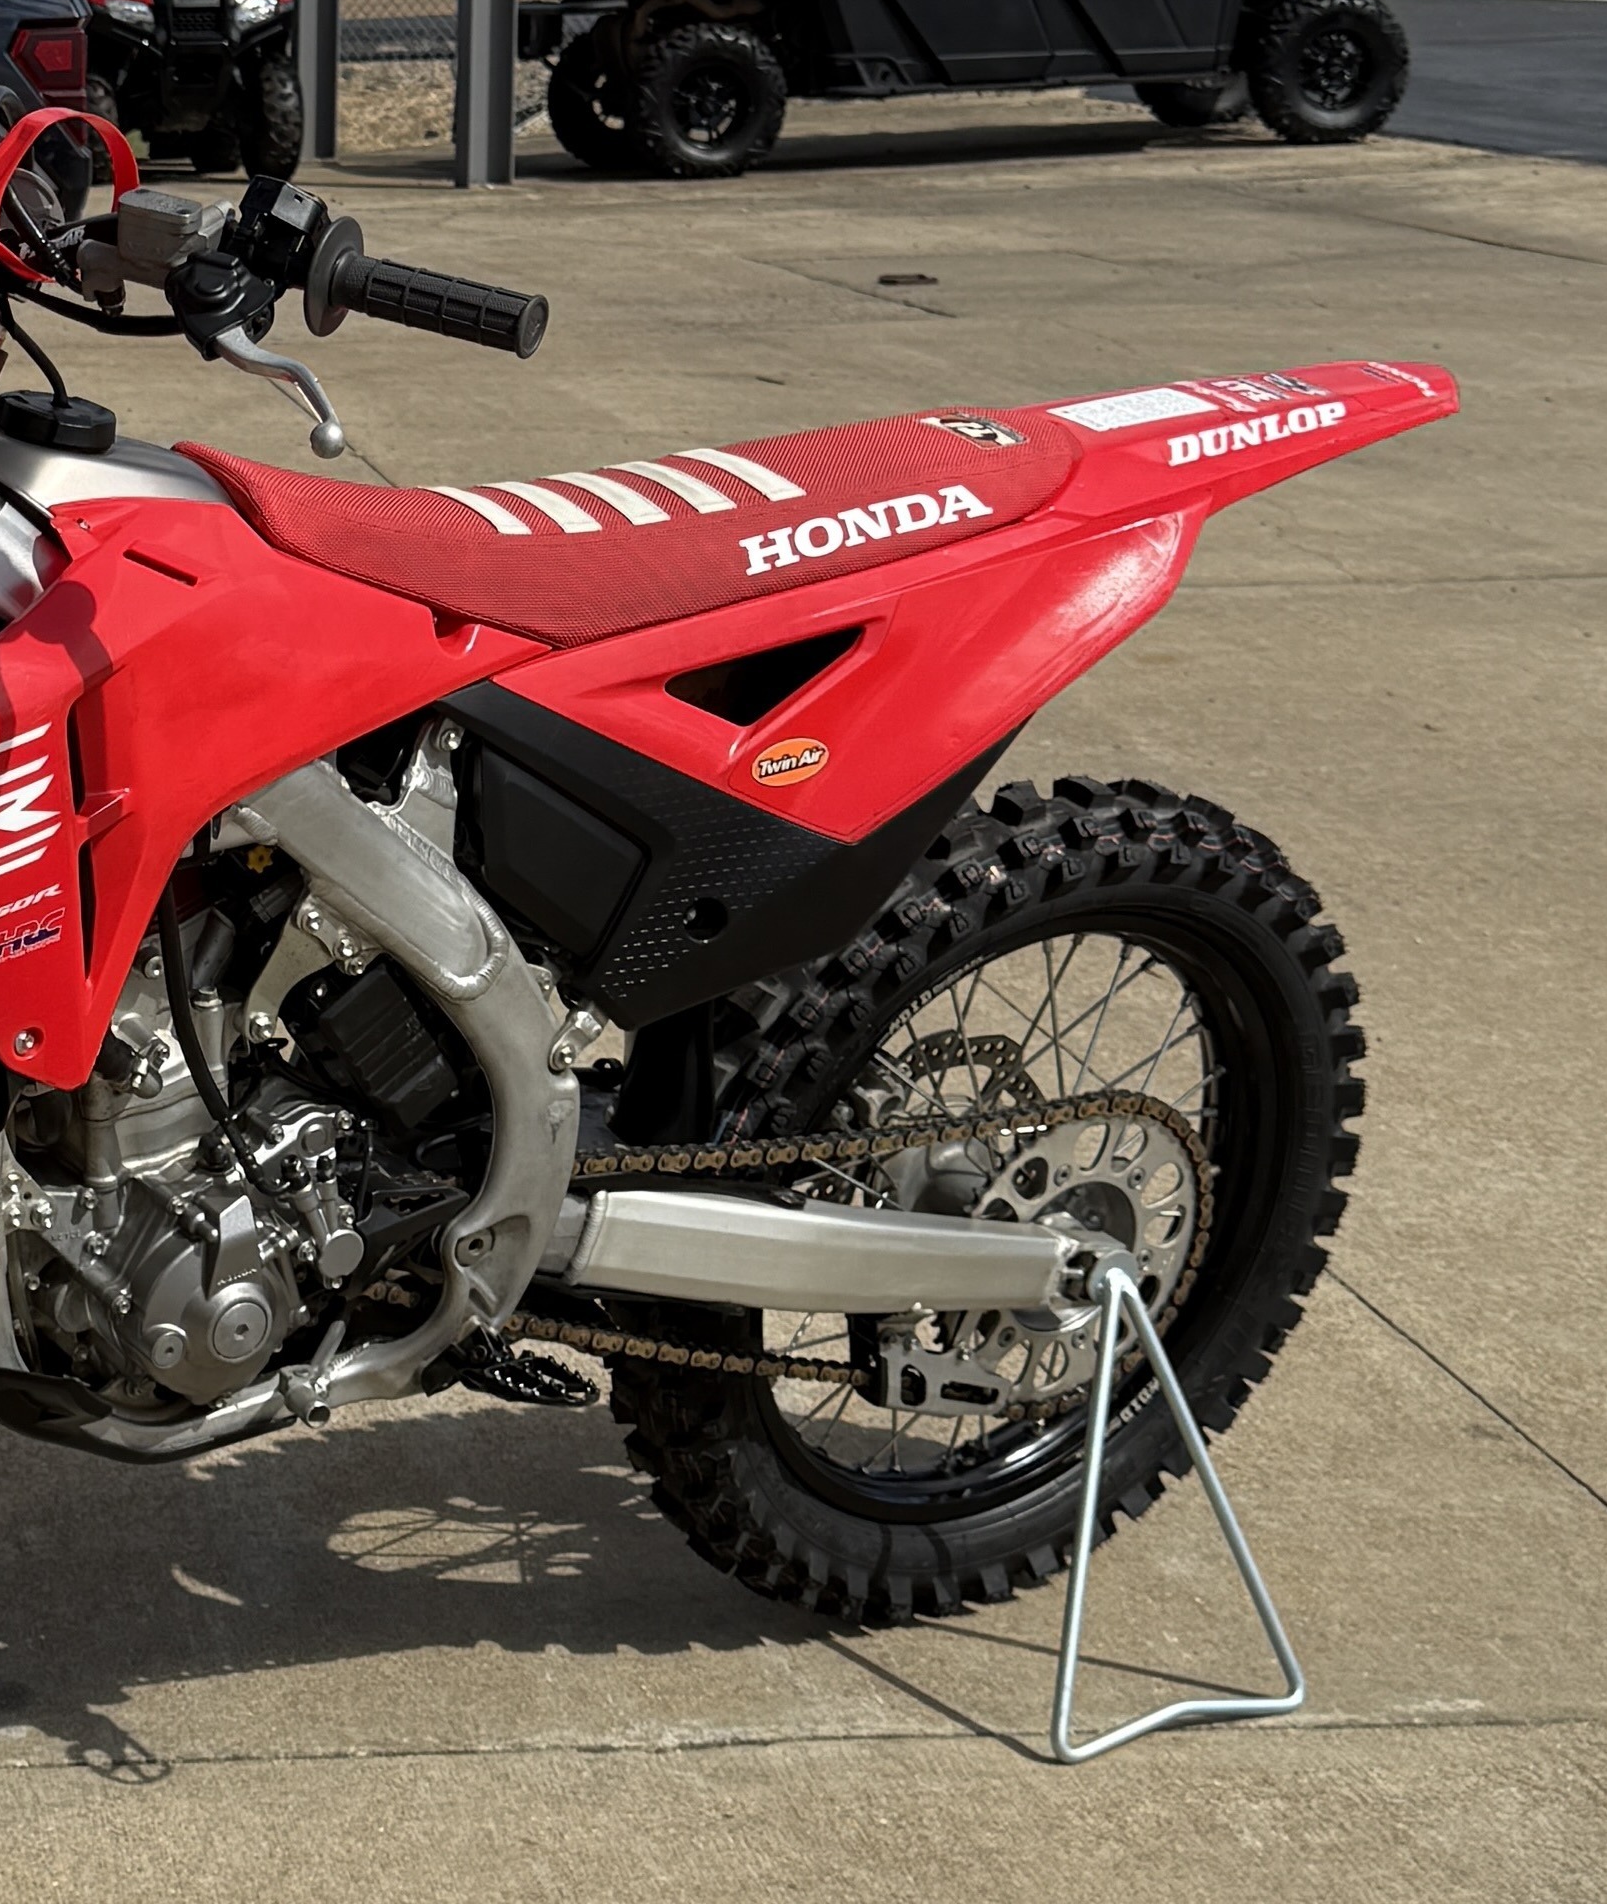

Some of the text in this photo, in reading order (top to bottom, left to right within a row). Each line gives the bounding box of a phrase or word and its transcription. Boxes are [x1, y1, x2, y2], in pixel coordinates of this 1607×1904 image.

[1166, 401, 1347, 467] DUNLOP
[739, 483, 993, 576] HONDA
[758, 747, 825, 778] Twin Air
